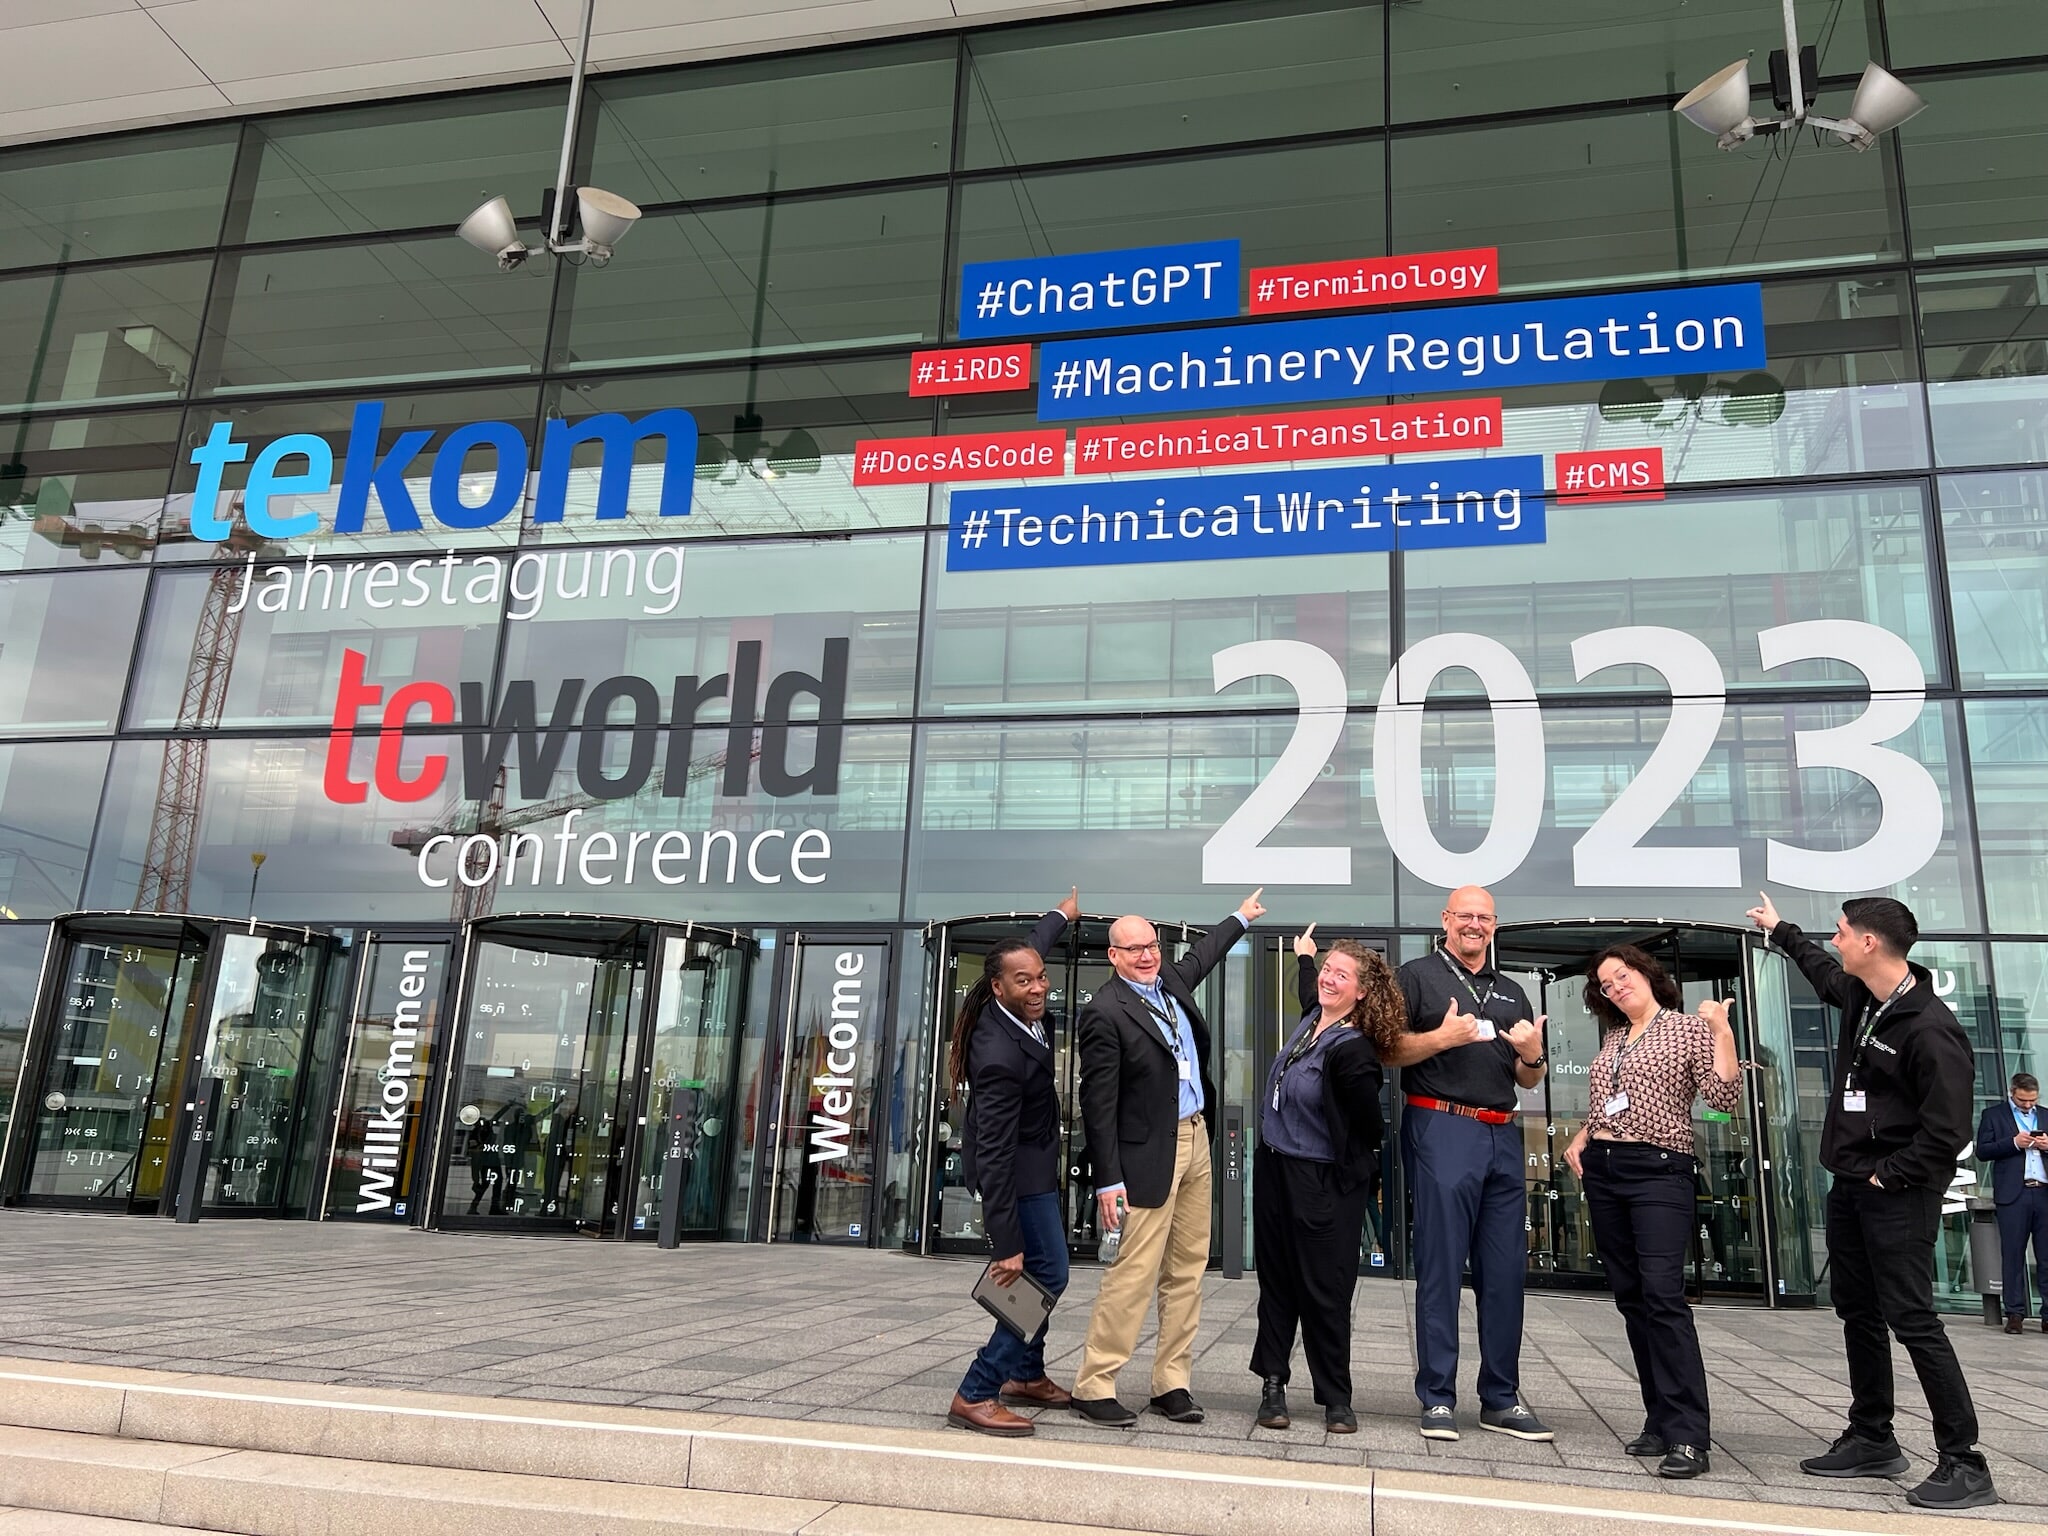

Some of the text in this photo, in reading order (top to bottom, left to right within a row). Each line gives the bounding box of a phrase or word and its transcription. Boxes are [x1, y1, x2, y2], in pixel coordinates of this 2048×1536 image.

[976, 261, 1223, 319] #ChatGPT
[1257, 263, 1488, 302] #Terminology
[916, 355, 1021, 384] #iiRDS
[190, 402, 699, 542] tekom
[861, 443, 1054, 474] #DocsAsCode
[1082, 411, 1492, 462] #TechnicalTranslation
[1564, 461, 1651, 490] #CMS
[960, 481, 1523, 549] #TechnicalWriting
[227, 544, 685, 620] Jahrestagung
[323, 637, 849, 804] tcworld
[1202, 619, 1944, 892] 2023
[417, 809, 832, 888] conference
[356, 950, 430, 1213] Willkommen
[808, 951, 864, 1164] Welcome
